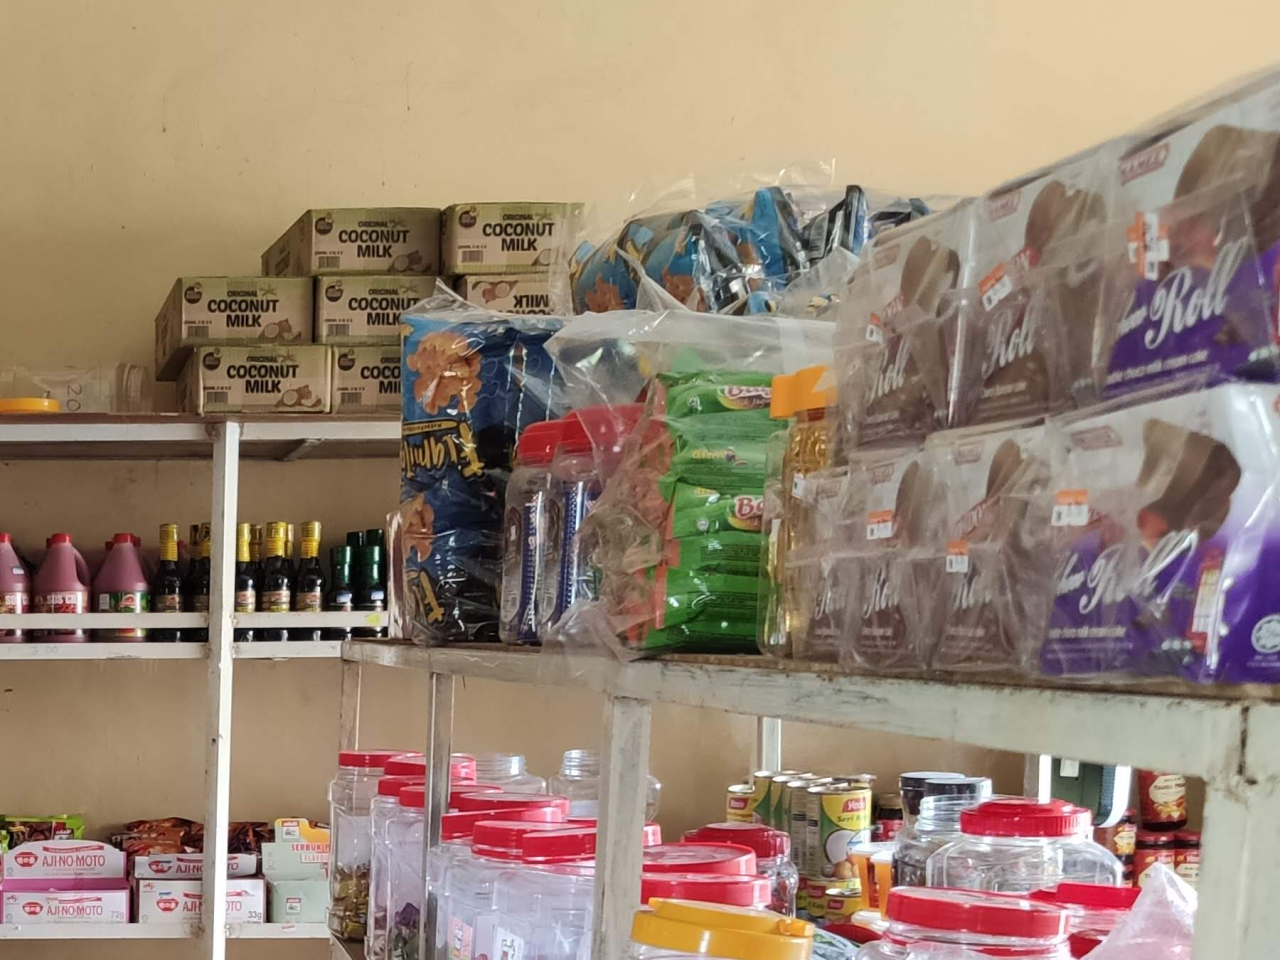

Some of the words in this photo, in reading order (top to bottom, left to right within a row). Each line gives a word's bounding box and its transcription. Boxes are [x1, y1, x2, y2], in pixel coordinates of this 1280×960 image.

[338, 229, 410, 244] COCONUT
[482, 222, 554, 237] COCONUT
[356, 245, 393, 258] MILK
[501, 238, 538, 252] MILK
[207, 299, 279, 313] COCONUT
[348, 297, 421, 311] COCONUT
[513, 294, 550, 308] MILK
[225, 314, 262, 328] MILK
[366, 312, 401, 326] MILK
[226, 364, 299, 379] COCONUT
[360, 366, 401, 380] COCO
[244, 379, 282, 394] MILK
[378, 381, 401, 394] MI
[110, 911, 124, 920] 72g
[247, 911, 262, 919] 33g
